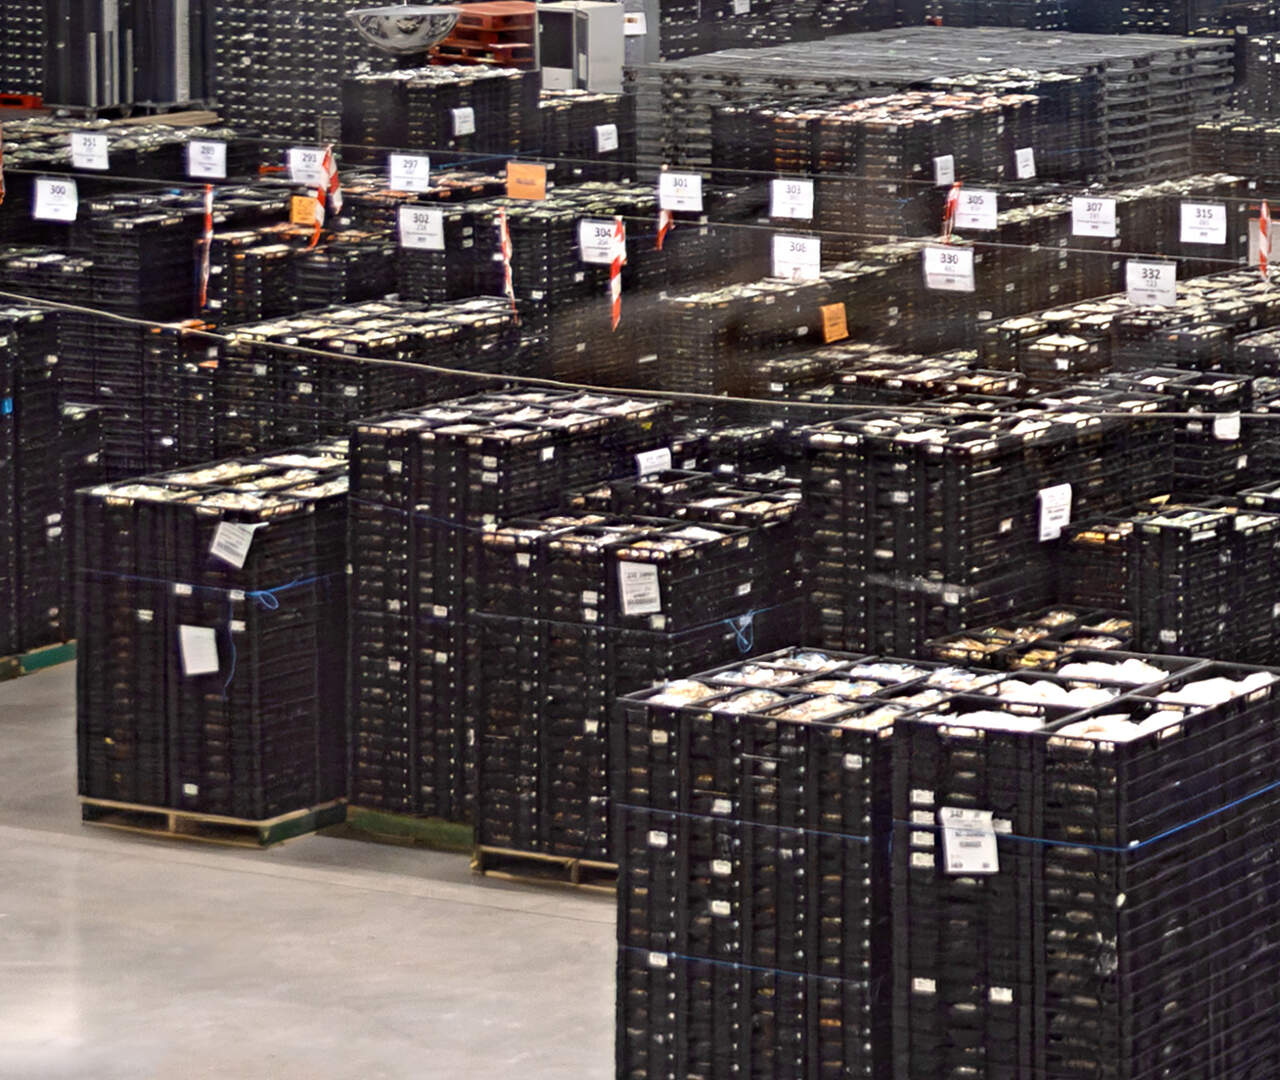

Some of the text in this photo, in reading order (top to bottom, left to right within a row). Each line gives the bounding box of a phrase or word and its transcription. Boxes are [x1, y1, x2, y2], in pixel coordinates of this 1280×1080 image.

[1086, 202, 1102, 212] 307
[1197, 208, 1213, 218] 315
[414, 213, 429, 224] 302
[595, 227, 611, 237] 304
[941, 253, 958, 264] 330
[1142, 268, 1160, 279] 332
